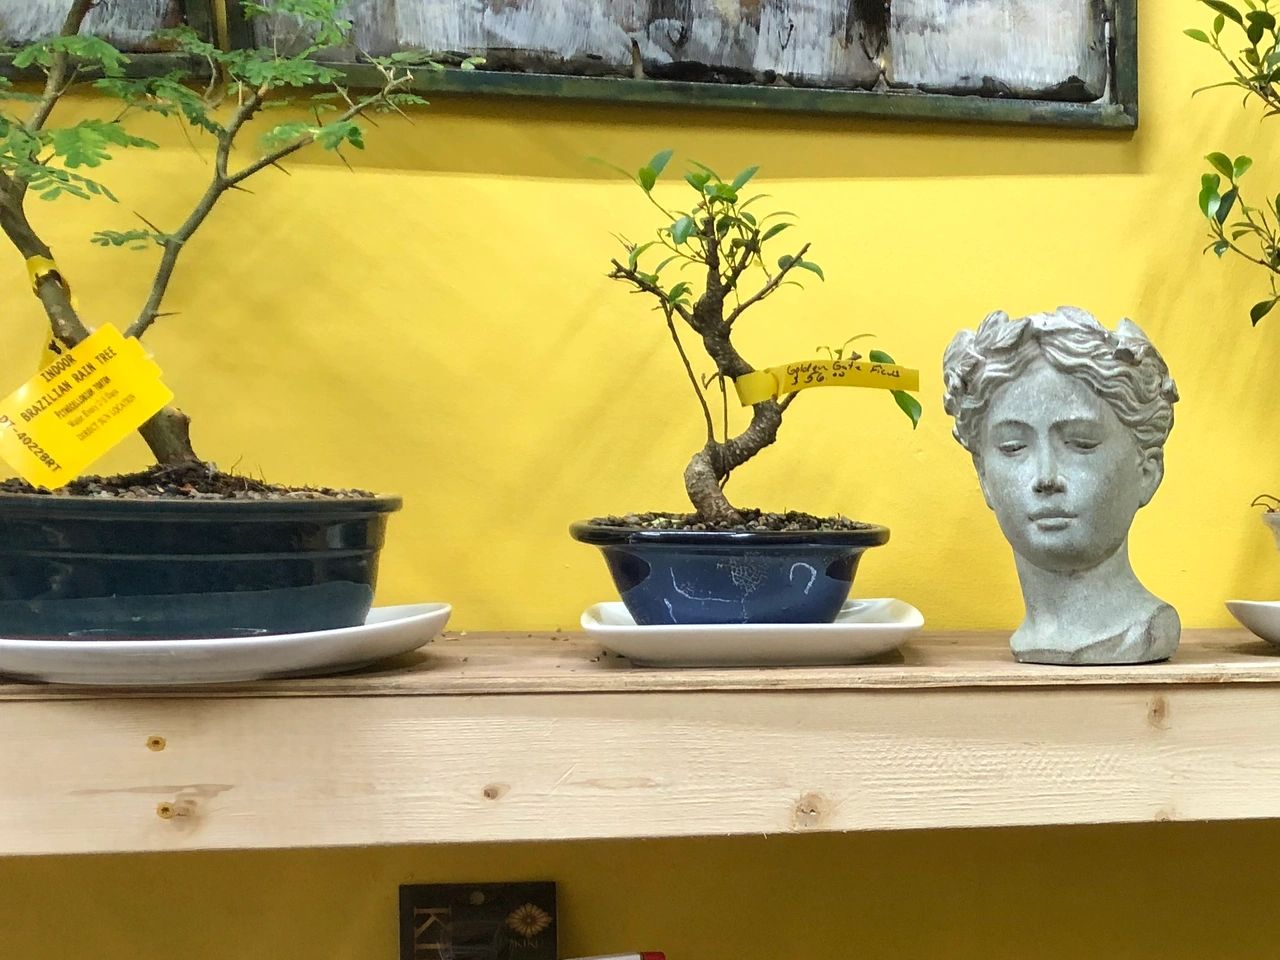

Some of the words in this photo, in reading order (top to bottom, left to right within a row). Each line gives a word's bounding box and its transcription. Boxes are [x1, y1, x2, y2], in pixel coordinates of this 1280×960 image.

[40, 353, 77, 383] INDOOR
[870, 365, 901, 378] Ficus
[20, 381, 73, 422] BRAZILIAN
[72, 364, 97, 383] RAIN
[95, 345, 118, 365] TREE
